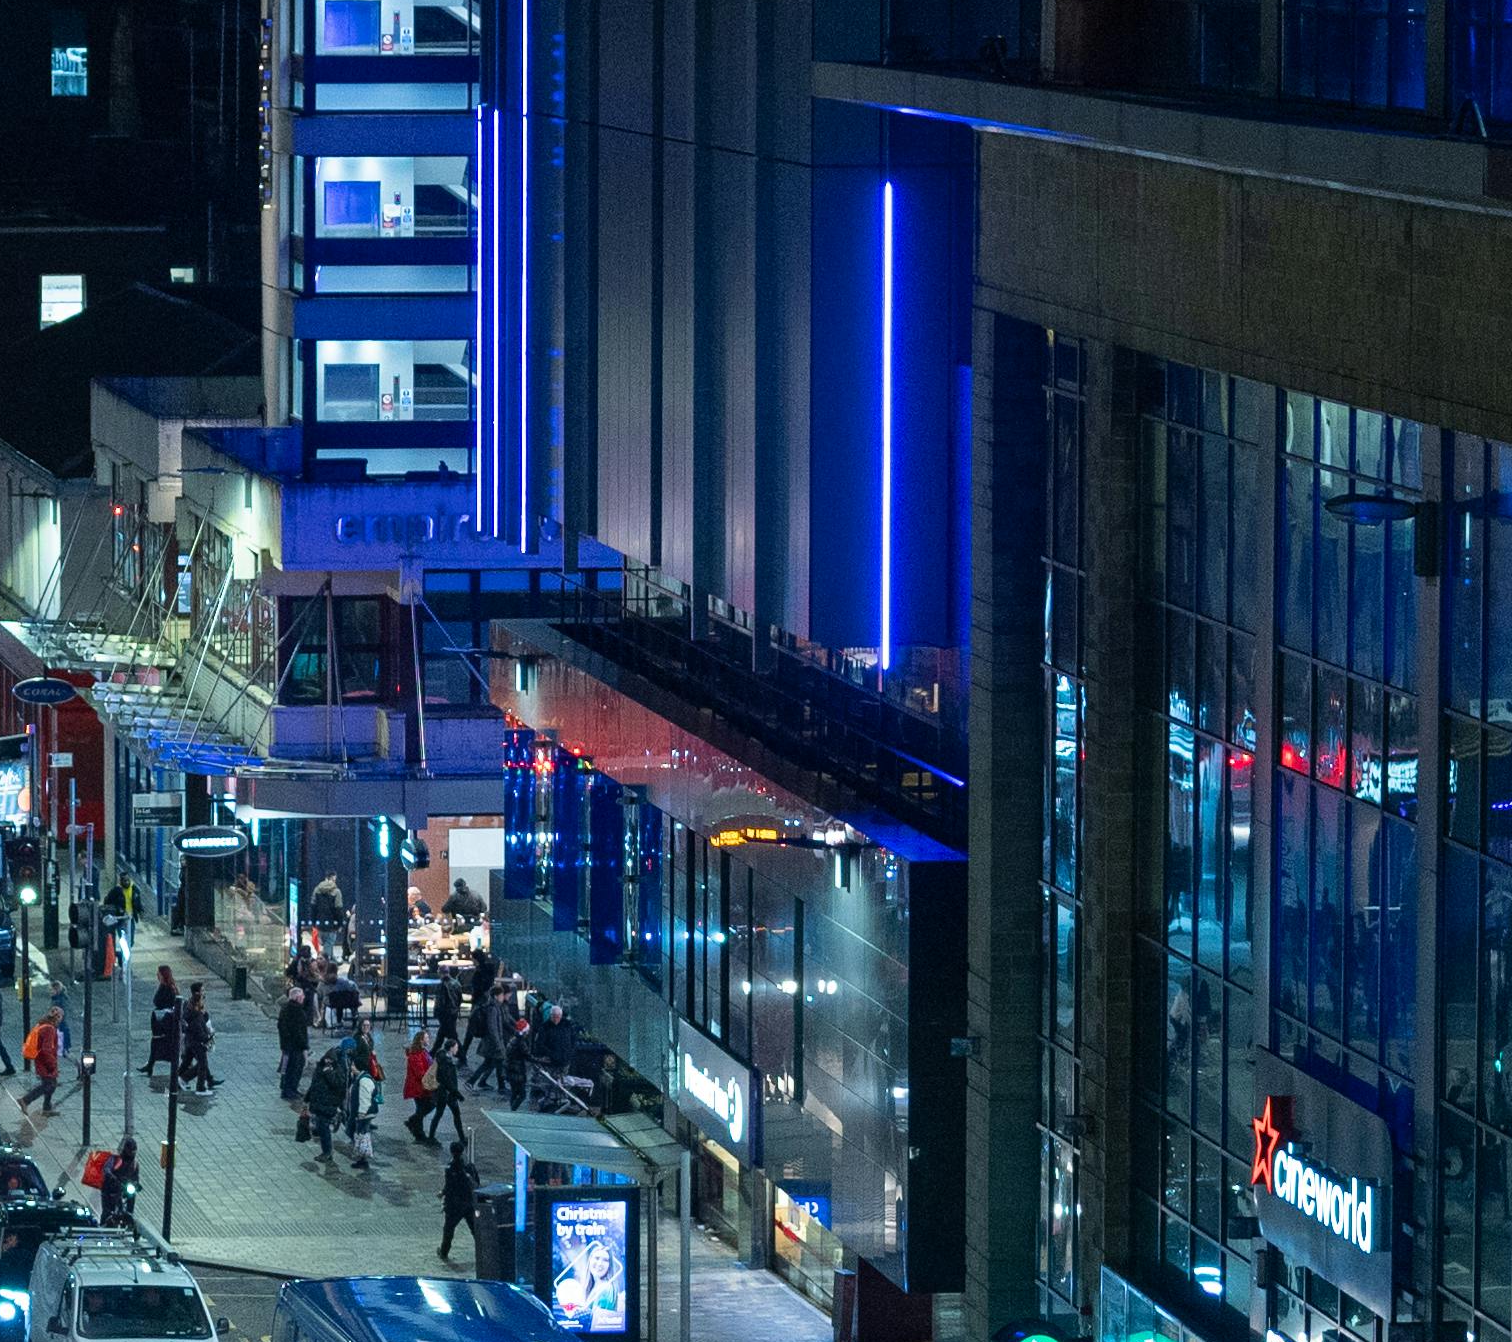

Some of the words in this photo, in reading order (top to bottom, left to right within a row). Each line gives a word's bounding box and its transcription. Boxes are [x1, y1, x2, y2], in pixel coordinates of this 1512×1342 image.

[556, 1222, 573, 1238] by
[575, 1221, 606, 1236] train
[1274, 1141, 1372, 1254] cineworld
